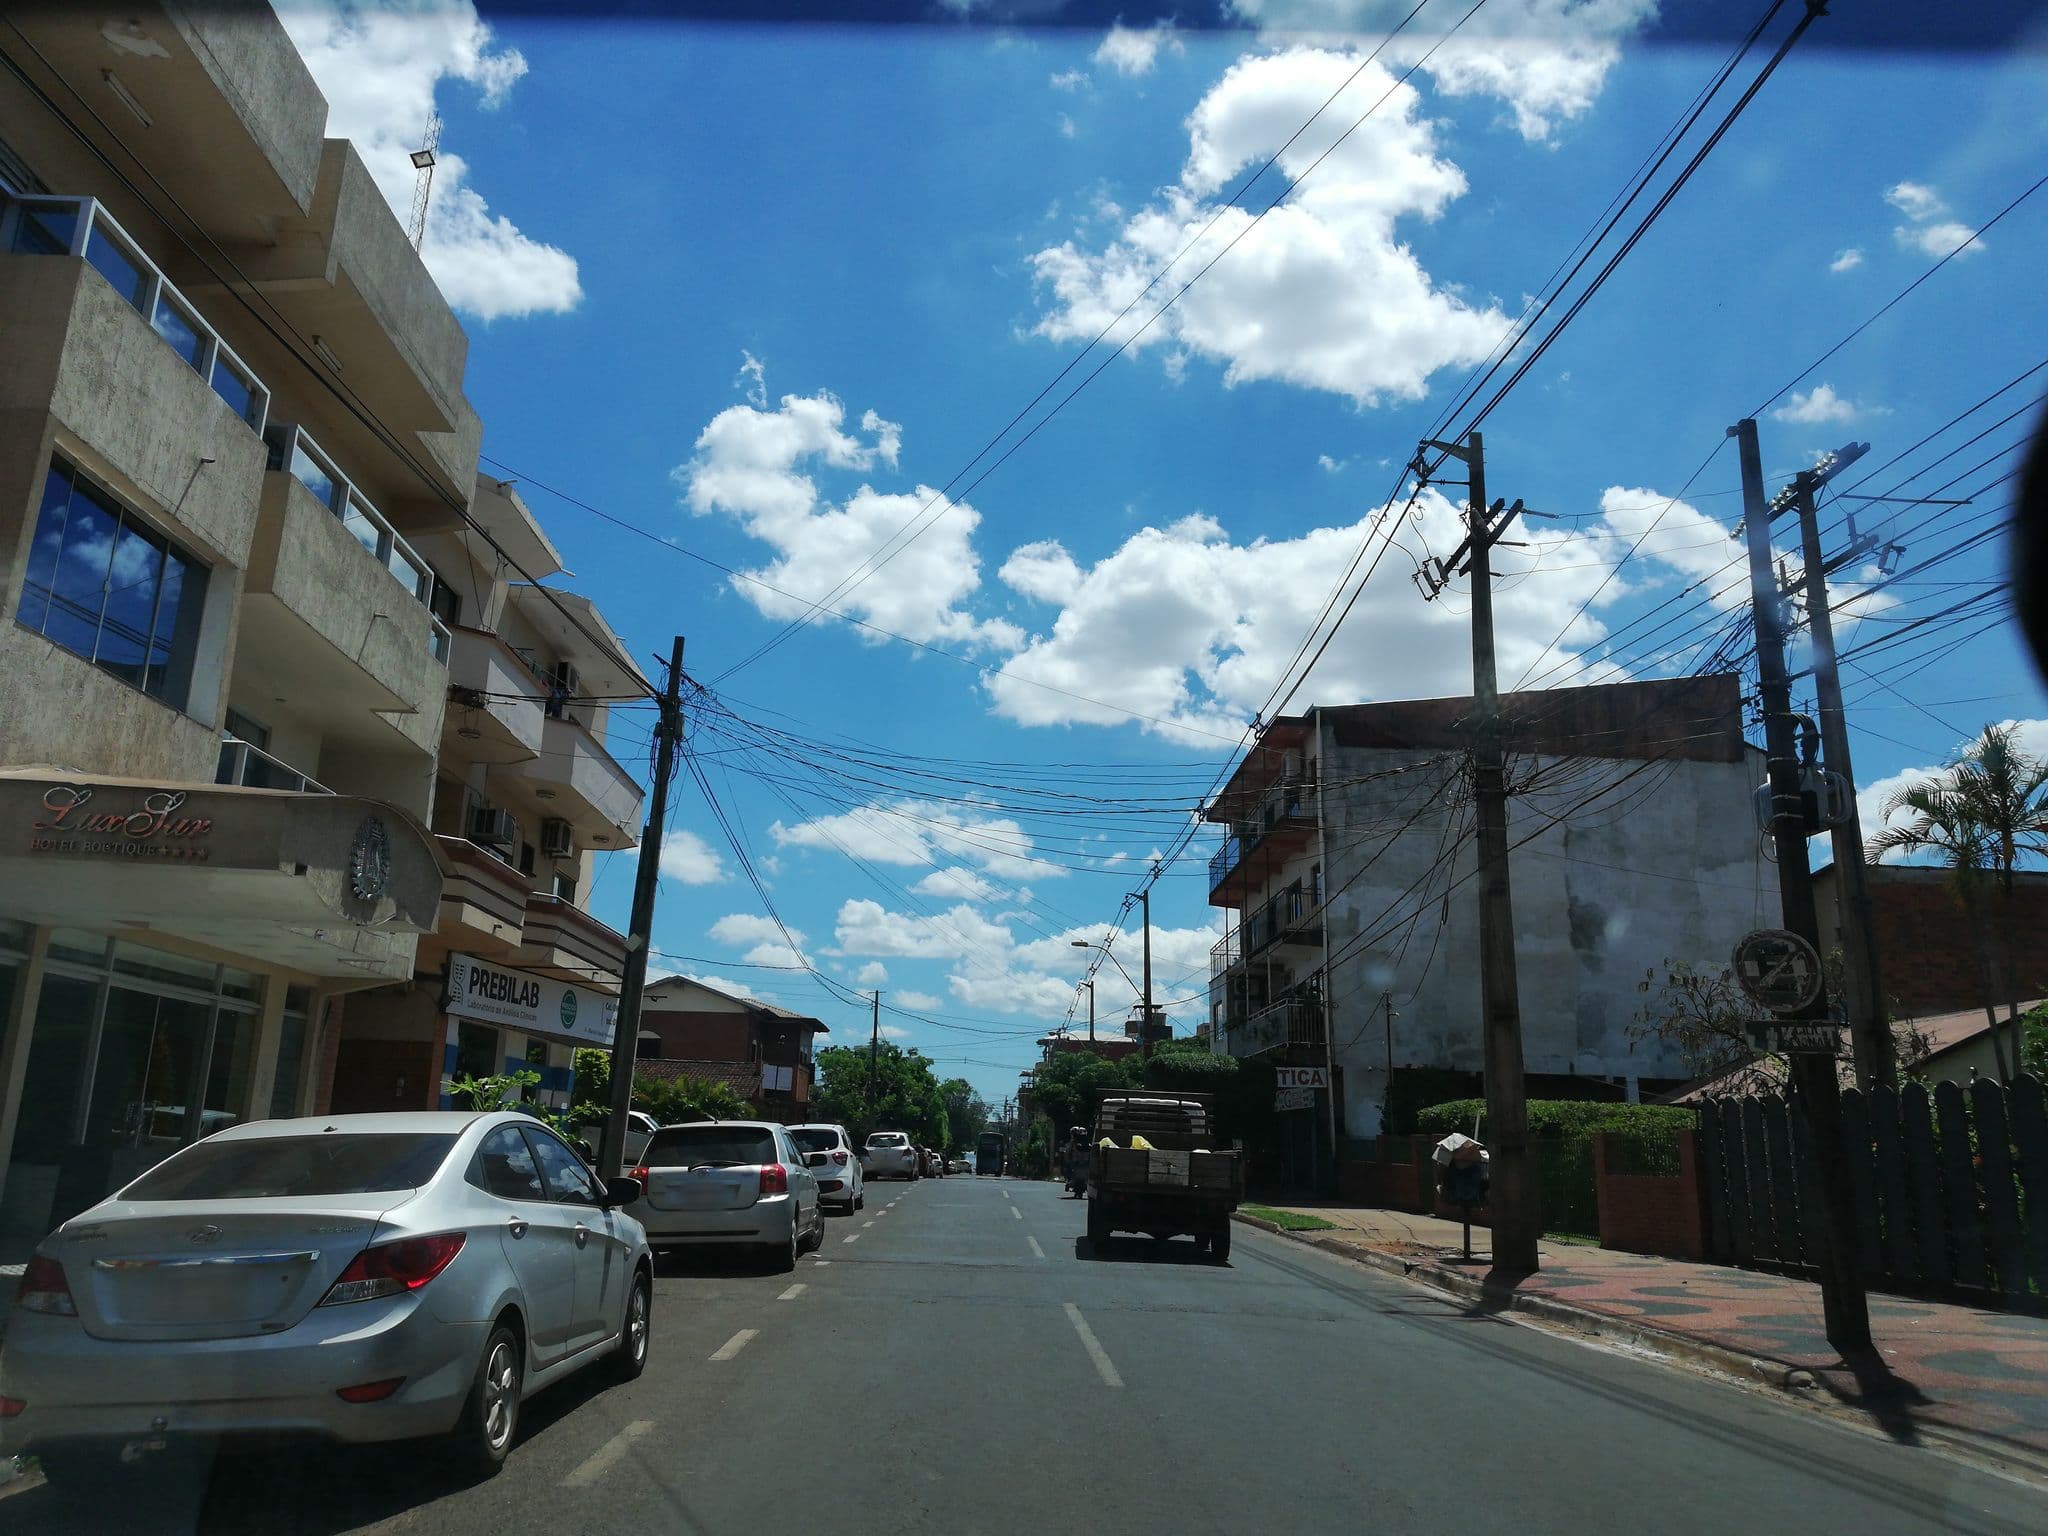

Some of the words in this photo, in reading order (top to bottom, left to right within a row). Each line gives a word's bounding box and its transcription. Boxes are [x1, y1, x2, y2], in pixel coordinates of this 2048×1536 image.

[30, 838, 75, 851] HOTEL
[83, 839, 156, 857] BOUTIQUE
[469, 966, 540, 1009] PREBILAB
[1279, 1069, 1324, 1086] TICA
